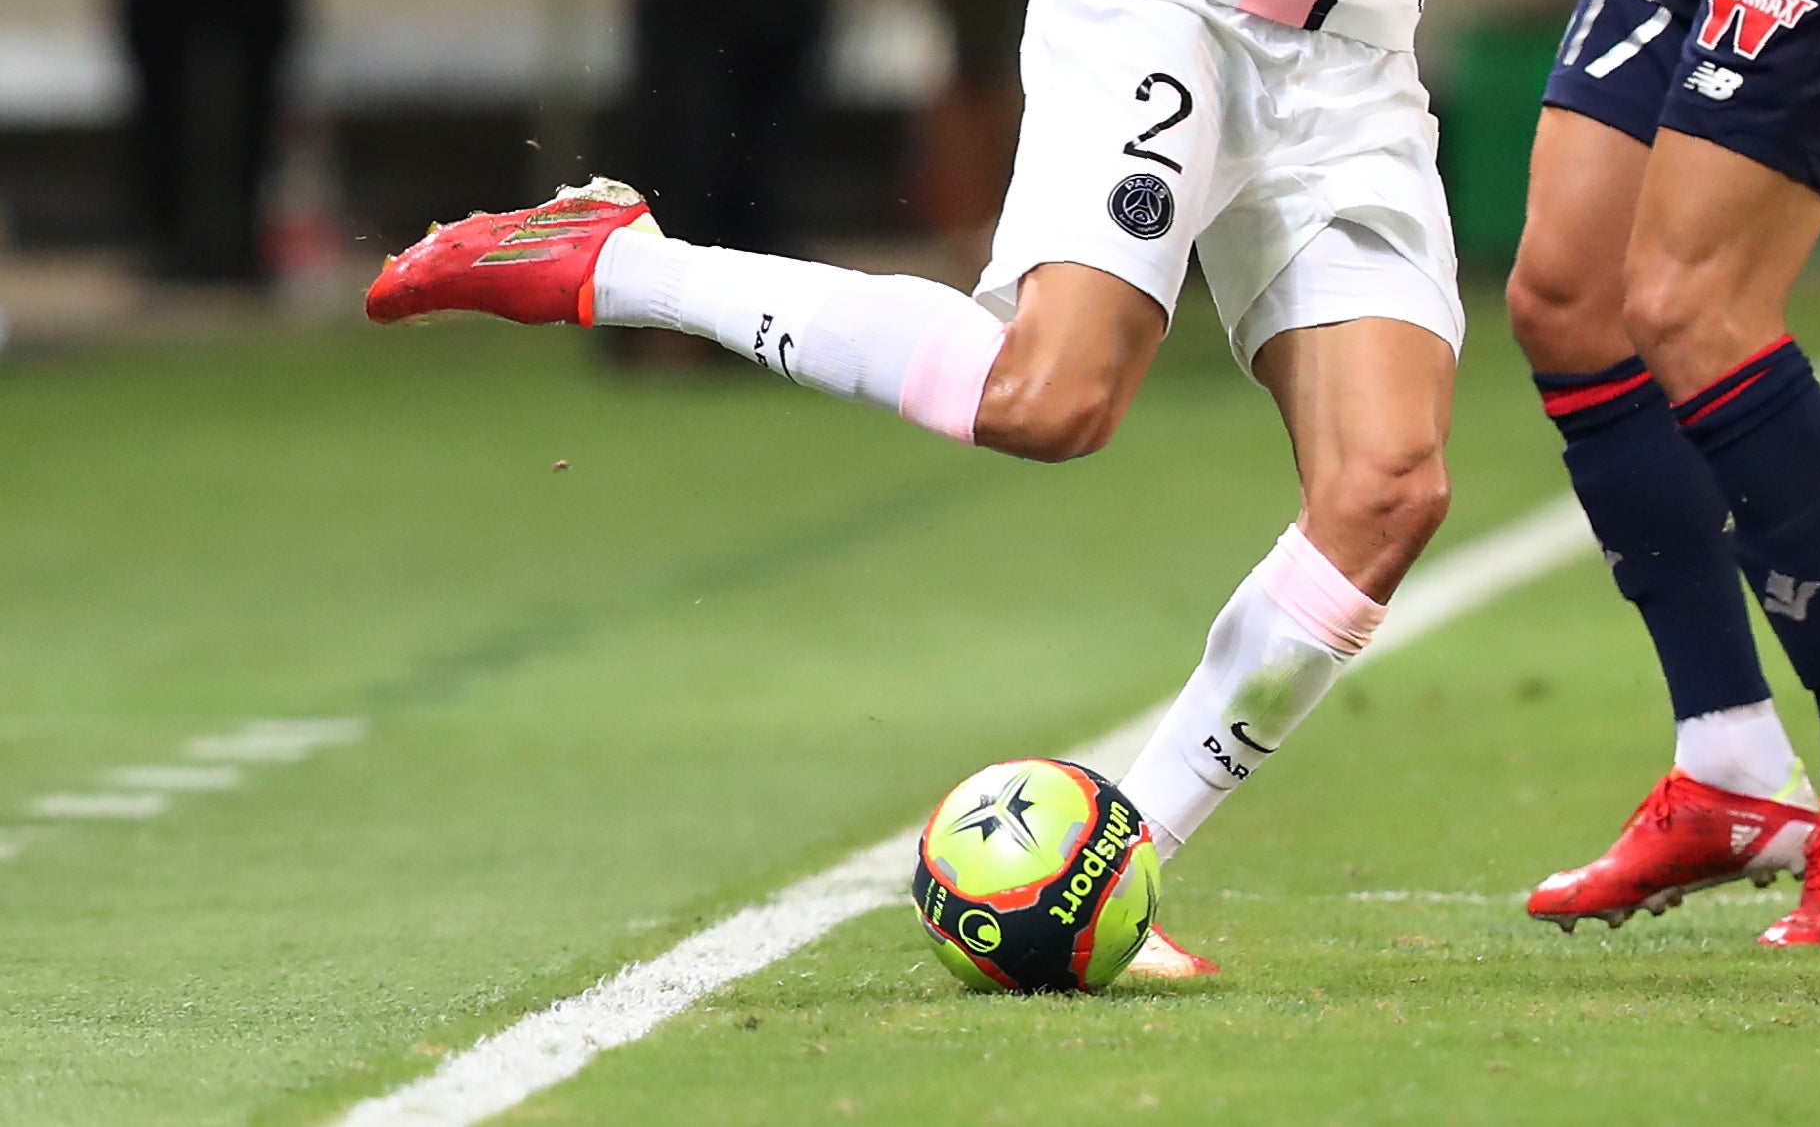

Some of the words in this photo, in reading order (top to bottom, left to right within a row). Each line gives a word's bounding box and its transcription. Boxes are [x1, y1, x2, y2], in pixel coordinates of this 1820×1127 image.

[1123, 72, 1193, 175] 2
[1124, 178, 1169, 199] PARIS
[1049, 800, 1132, 926] uhlsport
